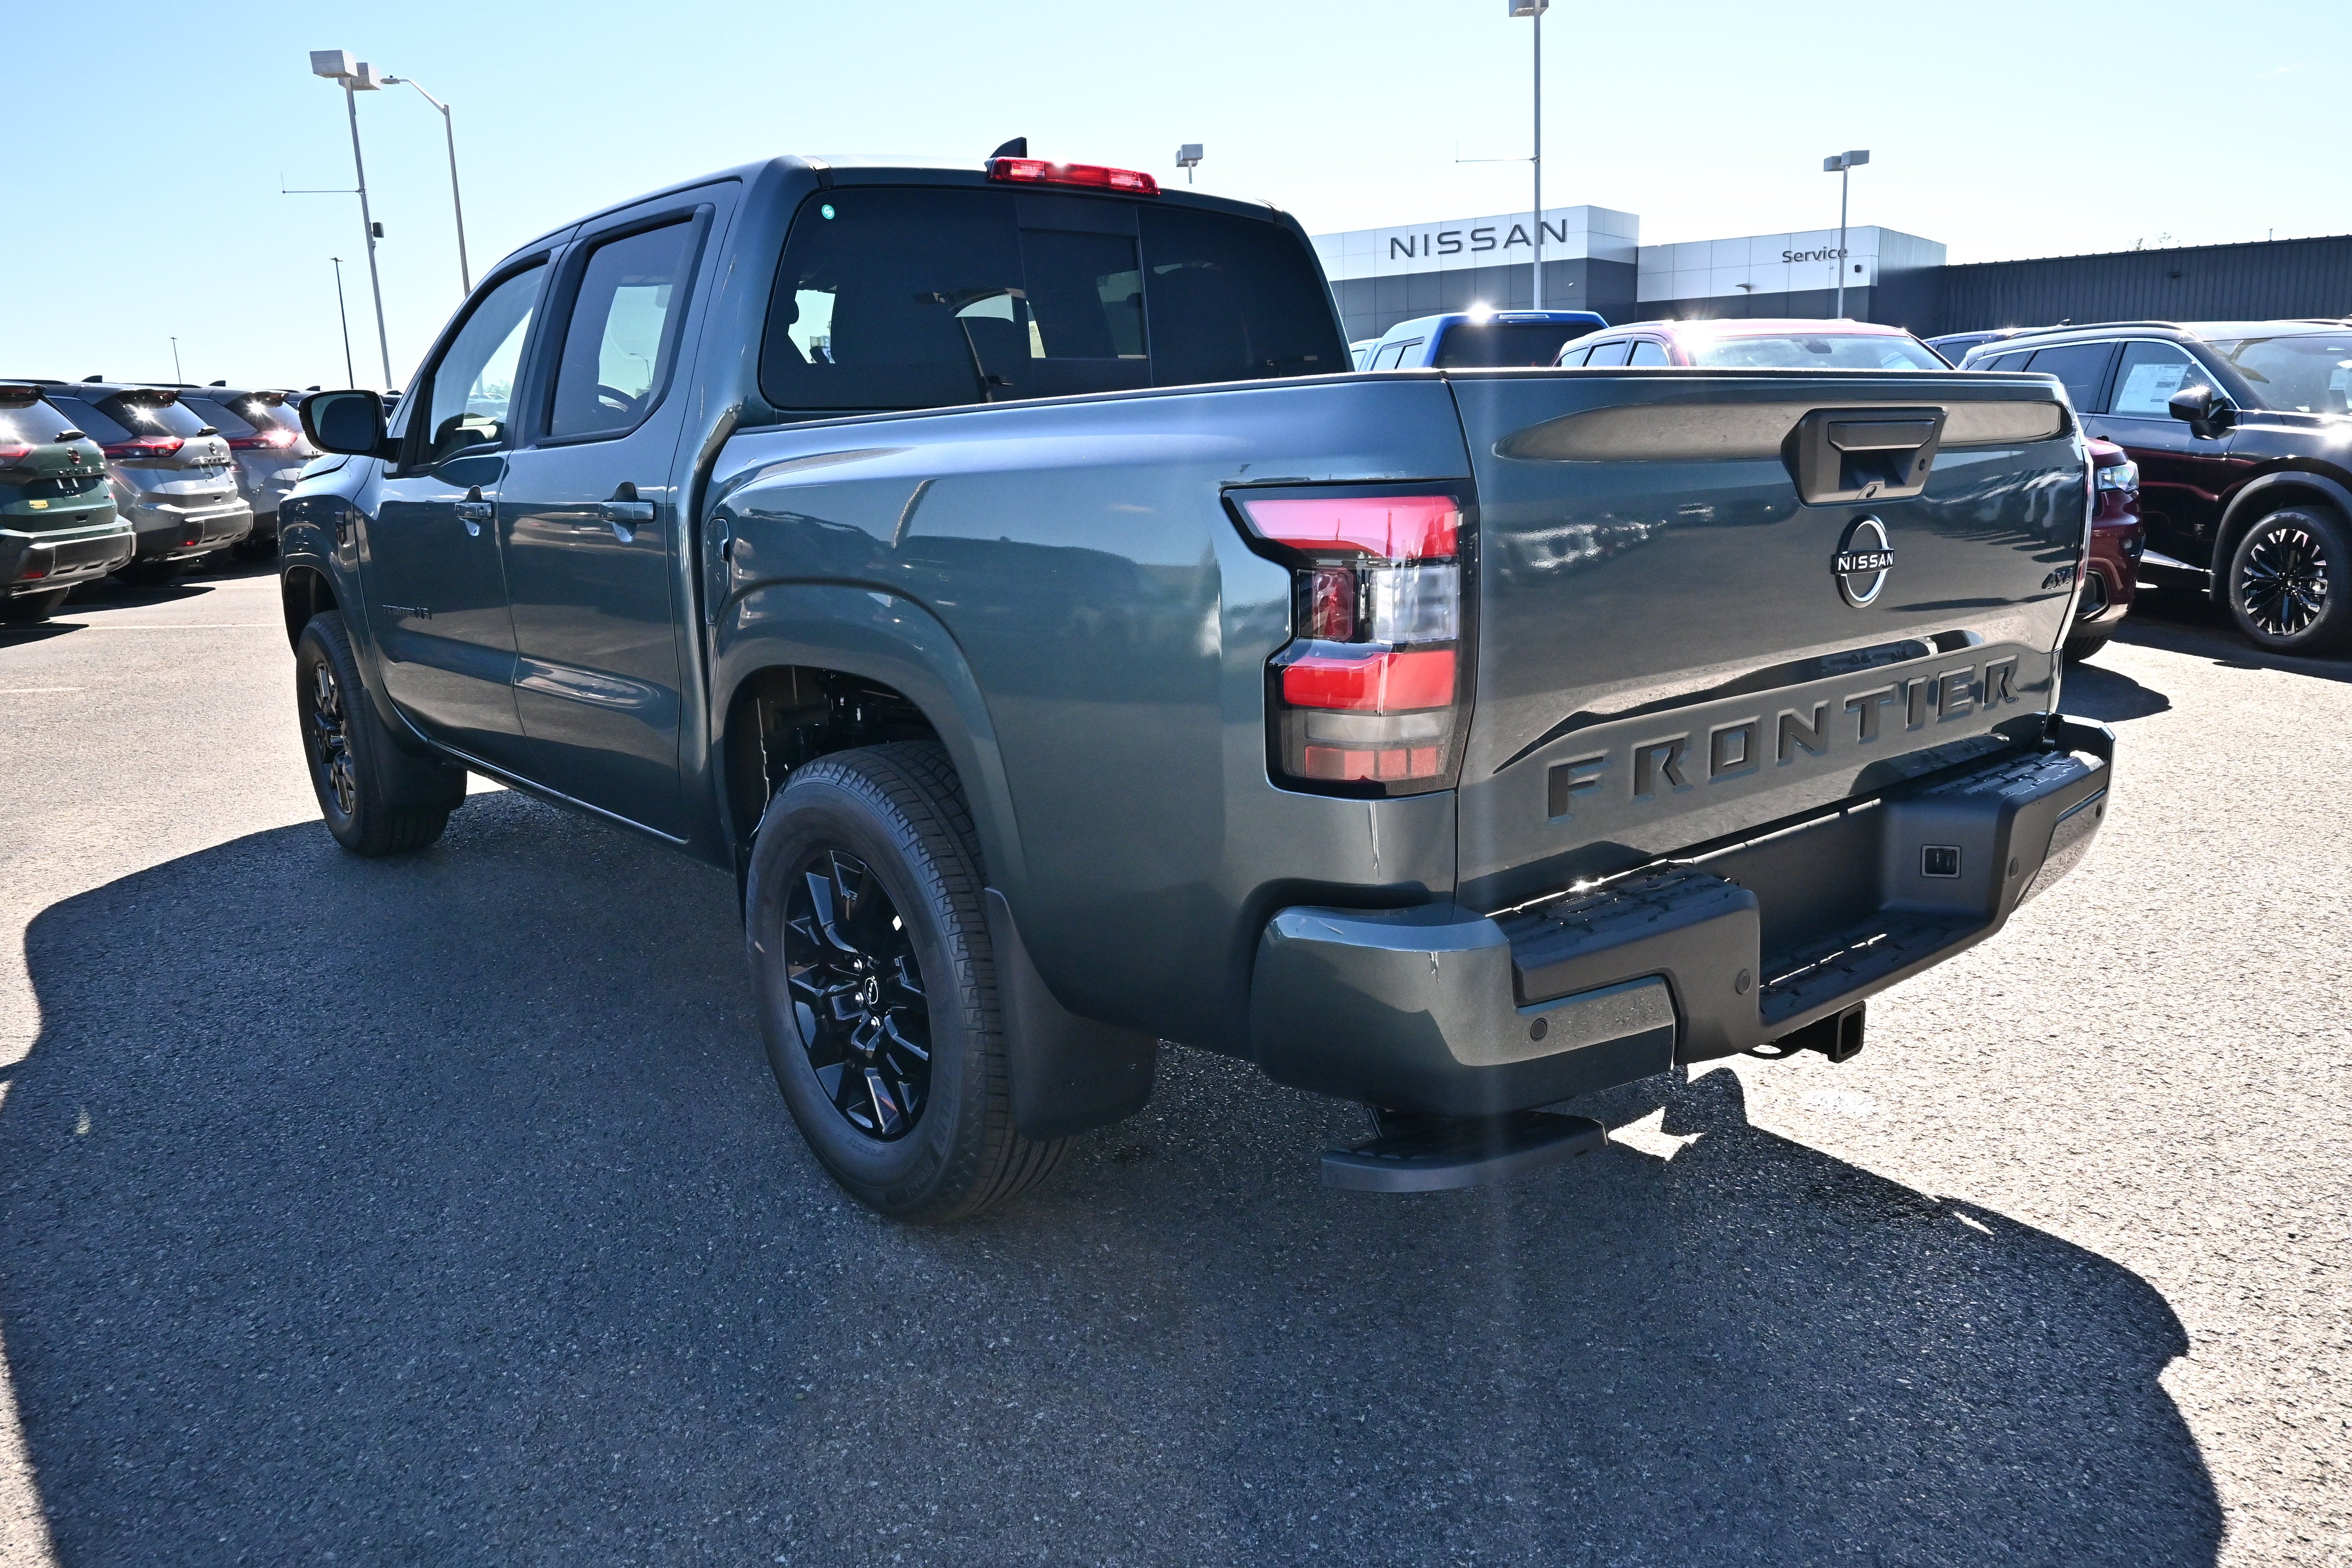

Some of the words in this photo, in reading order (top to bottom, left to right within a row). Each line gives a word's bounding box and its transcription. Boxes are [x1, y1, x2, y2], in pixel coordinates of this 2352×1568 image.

[1391, 219, 1567, 259] NISSAN
[1838, 553, 1893, 571] NISSAN
[1547, 654, 2019, 824] FRONTIER
